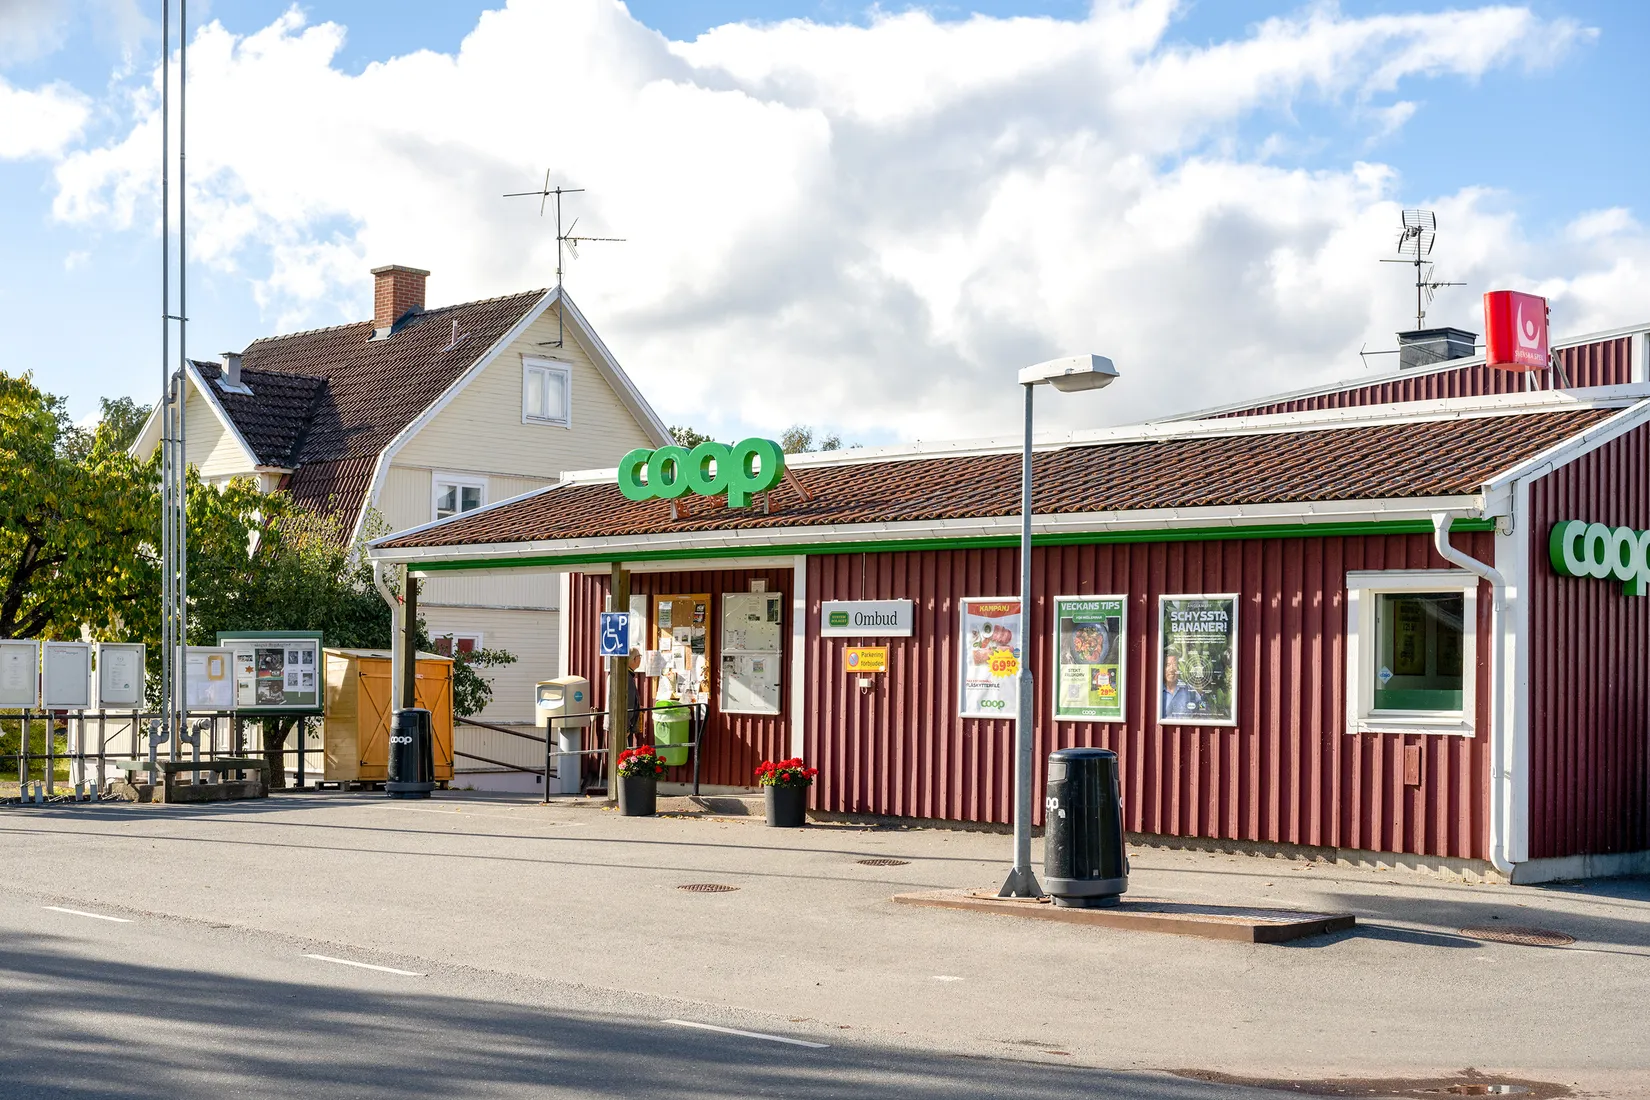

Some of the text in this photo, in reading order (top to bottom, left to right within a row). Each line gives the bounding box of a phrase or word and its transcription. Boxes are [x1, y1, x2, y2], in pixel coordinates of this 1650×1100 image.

[618, 437, 782, 508] coop
[1061, 601, 1120, 610] VECKANS TIPS
[854, 610, 898, 626] Ombud
[1170, 611, 1229, 621] SCHYSSTA
[618, 615, 628, 631] P
[1171, 622, 1228, 632] BANANER!
[860, 651, 884, 659] Parkering
[980, 699, 1006, 709] coop
